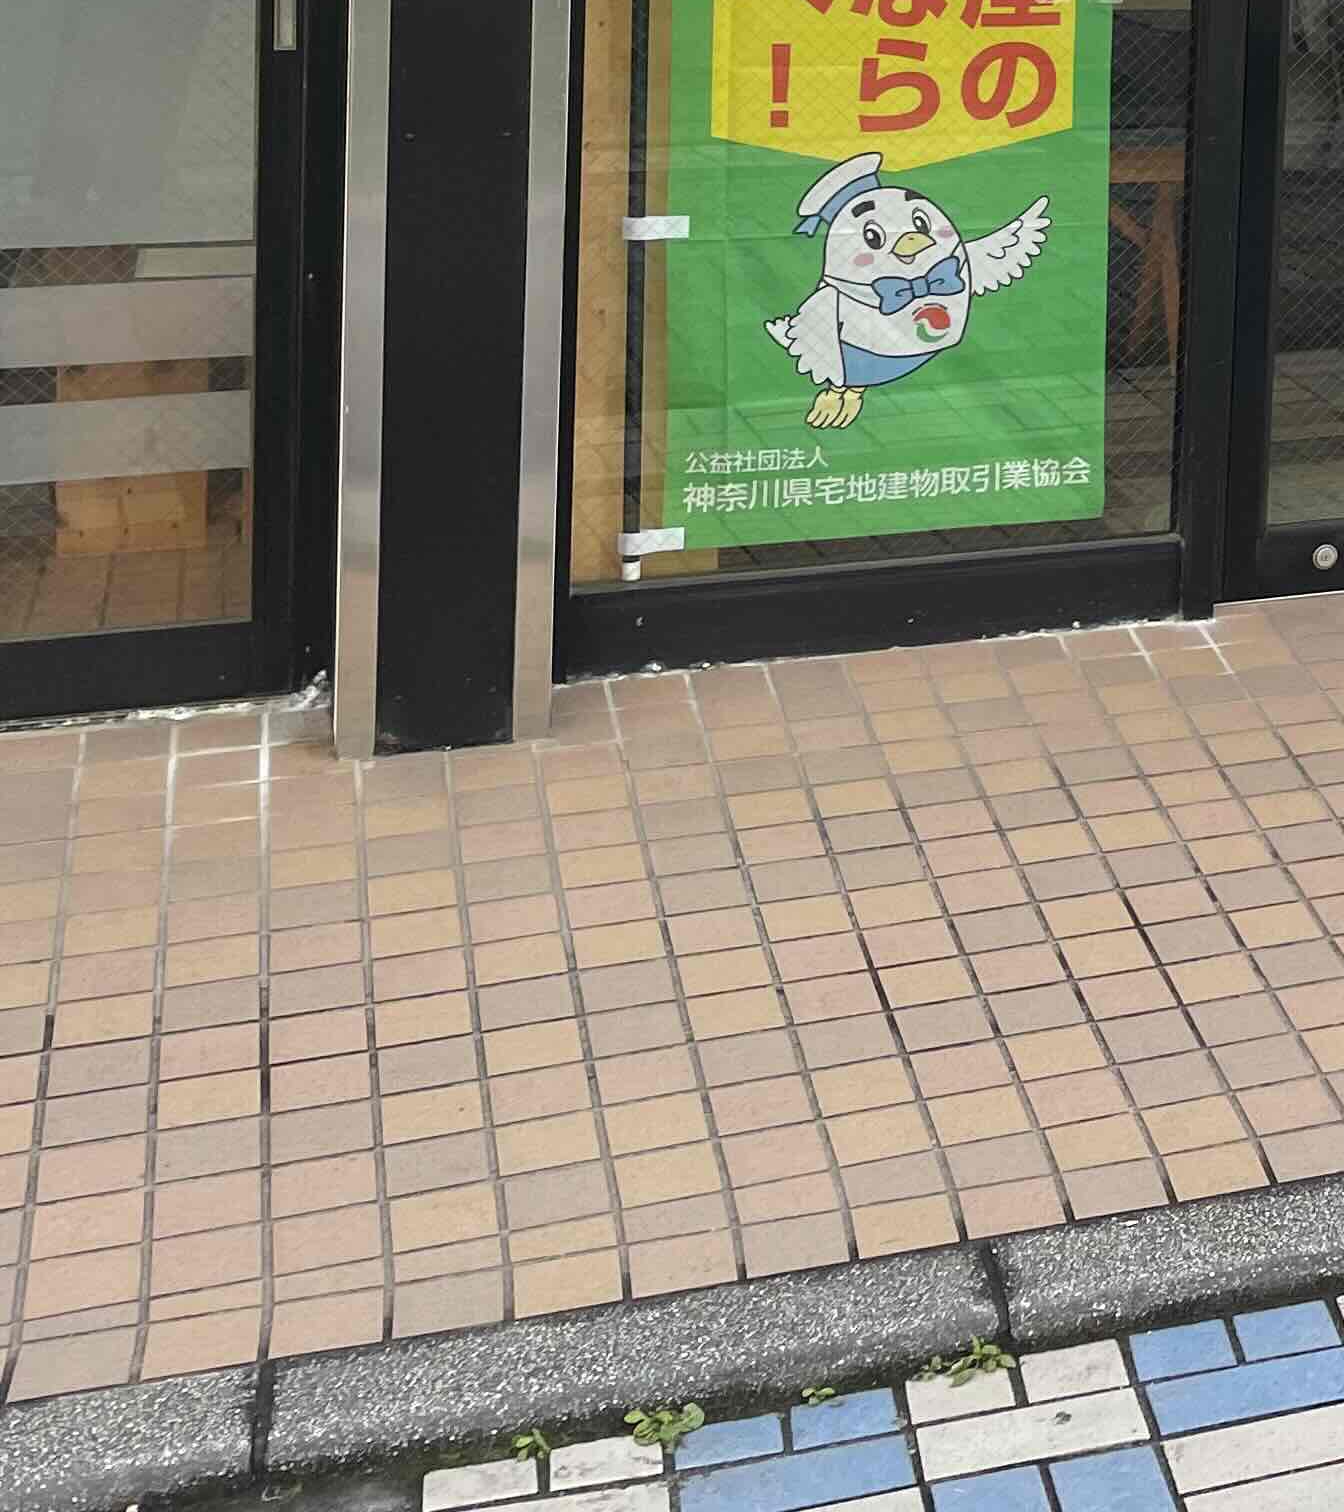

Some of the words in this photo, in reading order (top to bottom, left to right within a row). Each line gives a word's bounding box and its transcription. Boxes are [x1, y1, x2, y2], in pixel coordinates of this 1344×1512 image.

[685, 446, 829, 475] 公益社団法人
[682, 456, 1091, 514] 神奈川県宅地建物取引業協会
